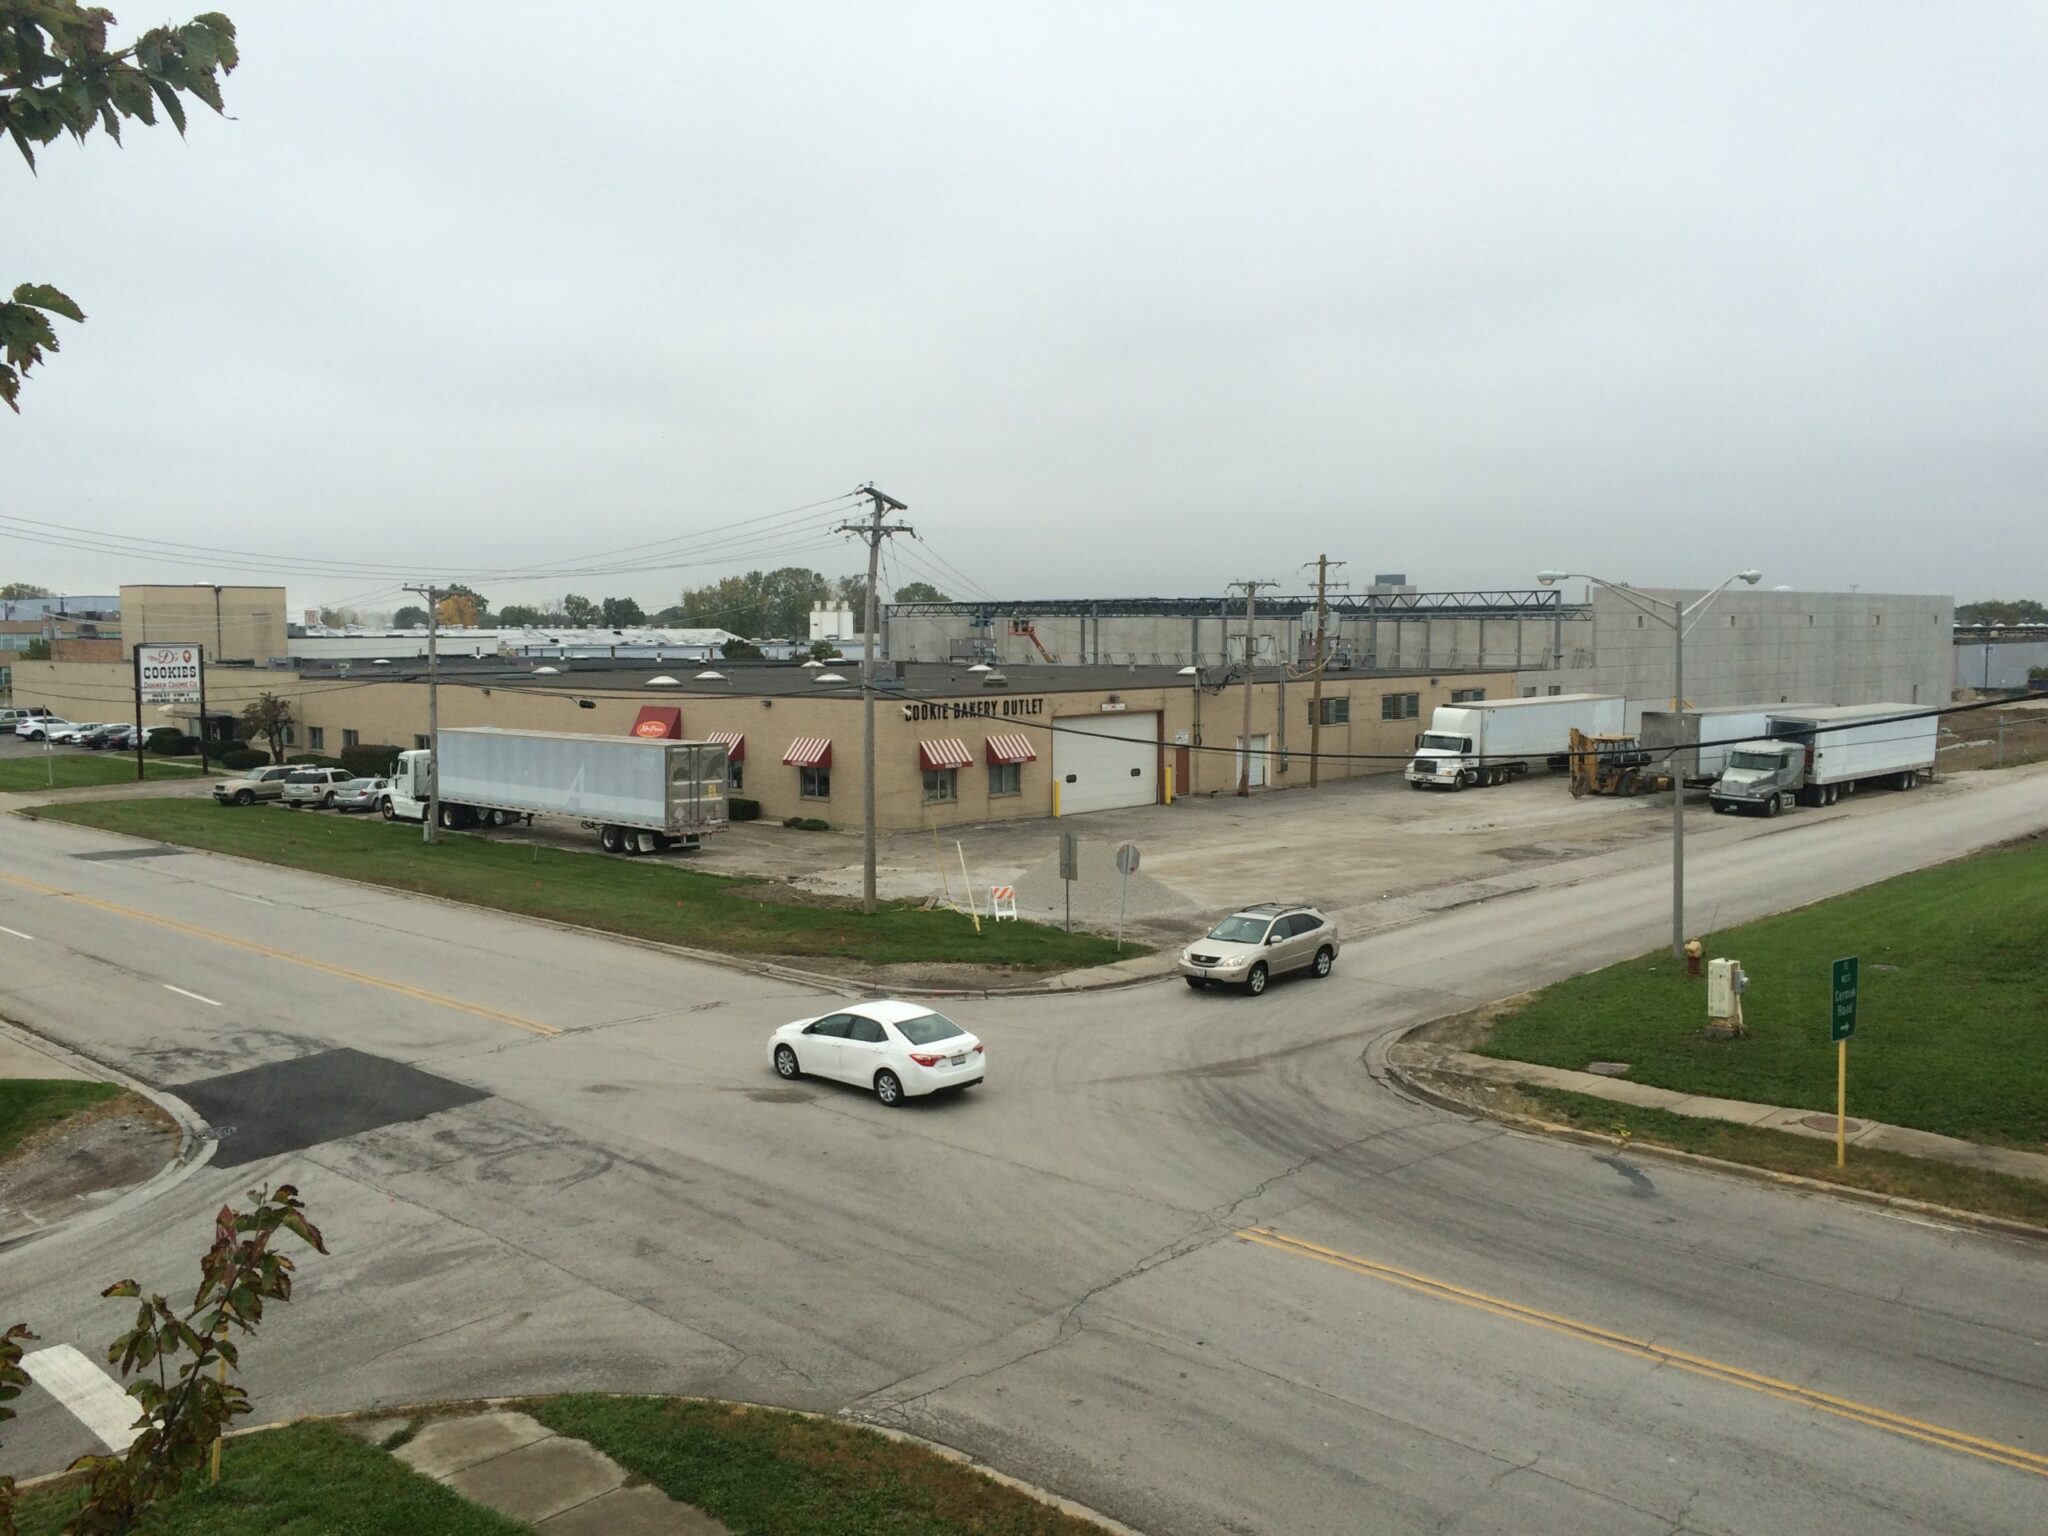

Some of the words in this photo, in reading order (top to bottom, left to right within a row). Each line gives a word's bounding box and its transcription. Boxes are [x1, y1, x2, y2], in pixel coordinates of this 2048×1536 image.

[143, 666, 196, 679] COOKIES
[904, 703, 949, 722] COOKIE
[953, 701, 998, 719] BAKERY
[1003, 698, 1044, 715] OUTLET
